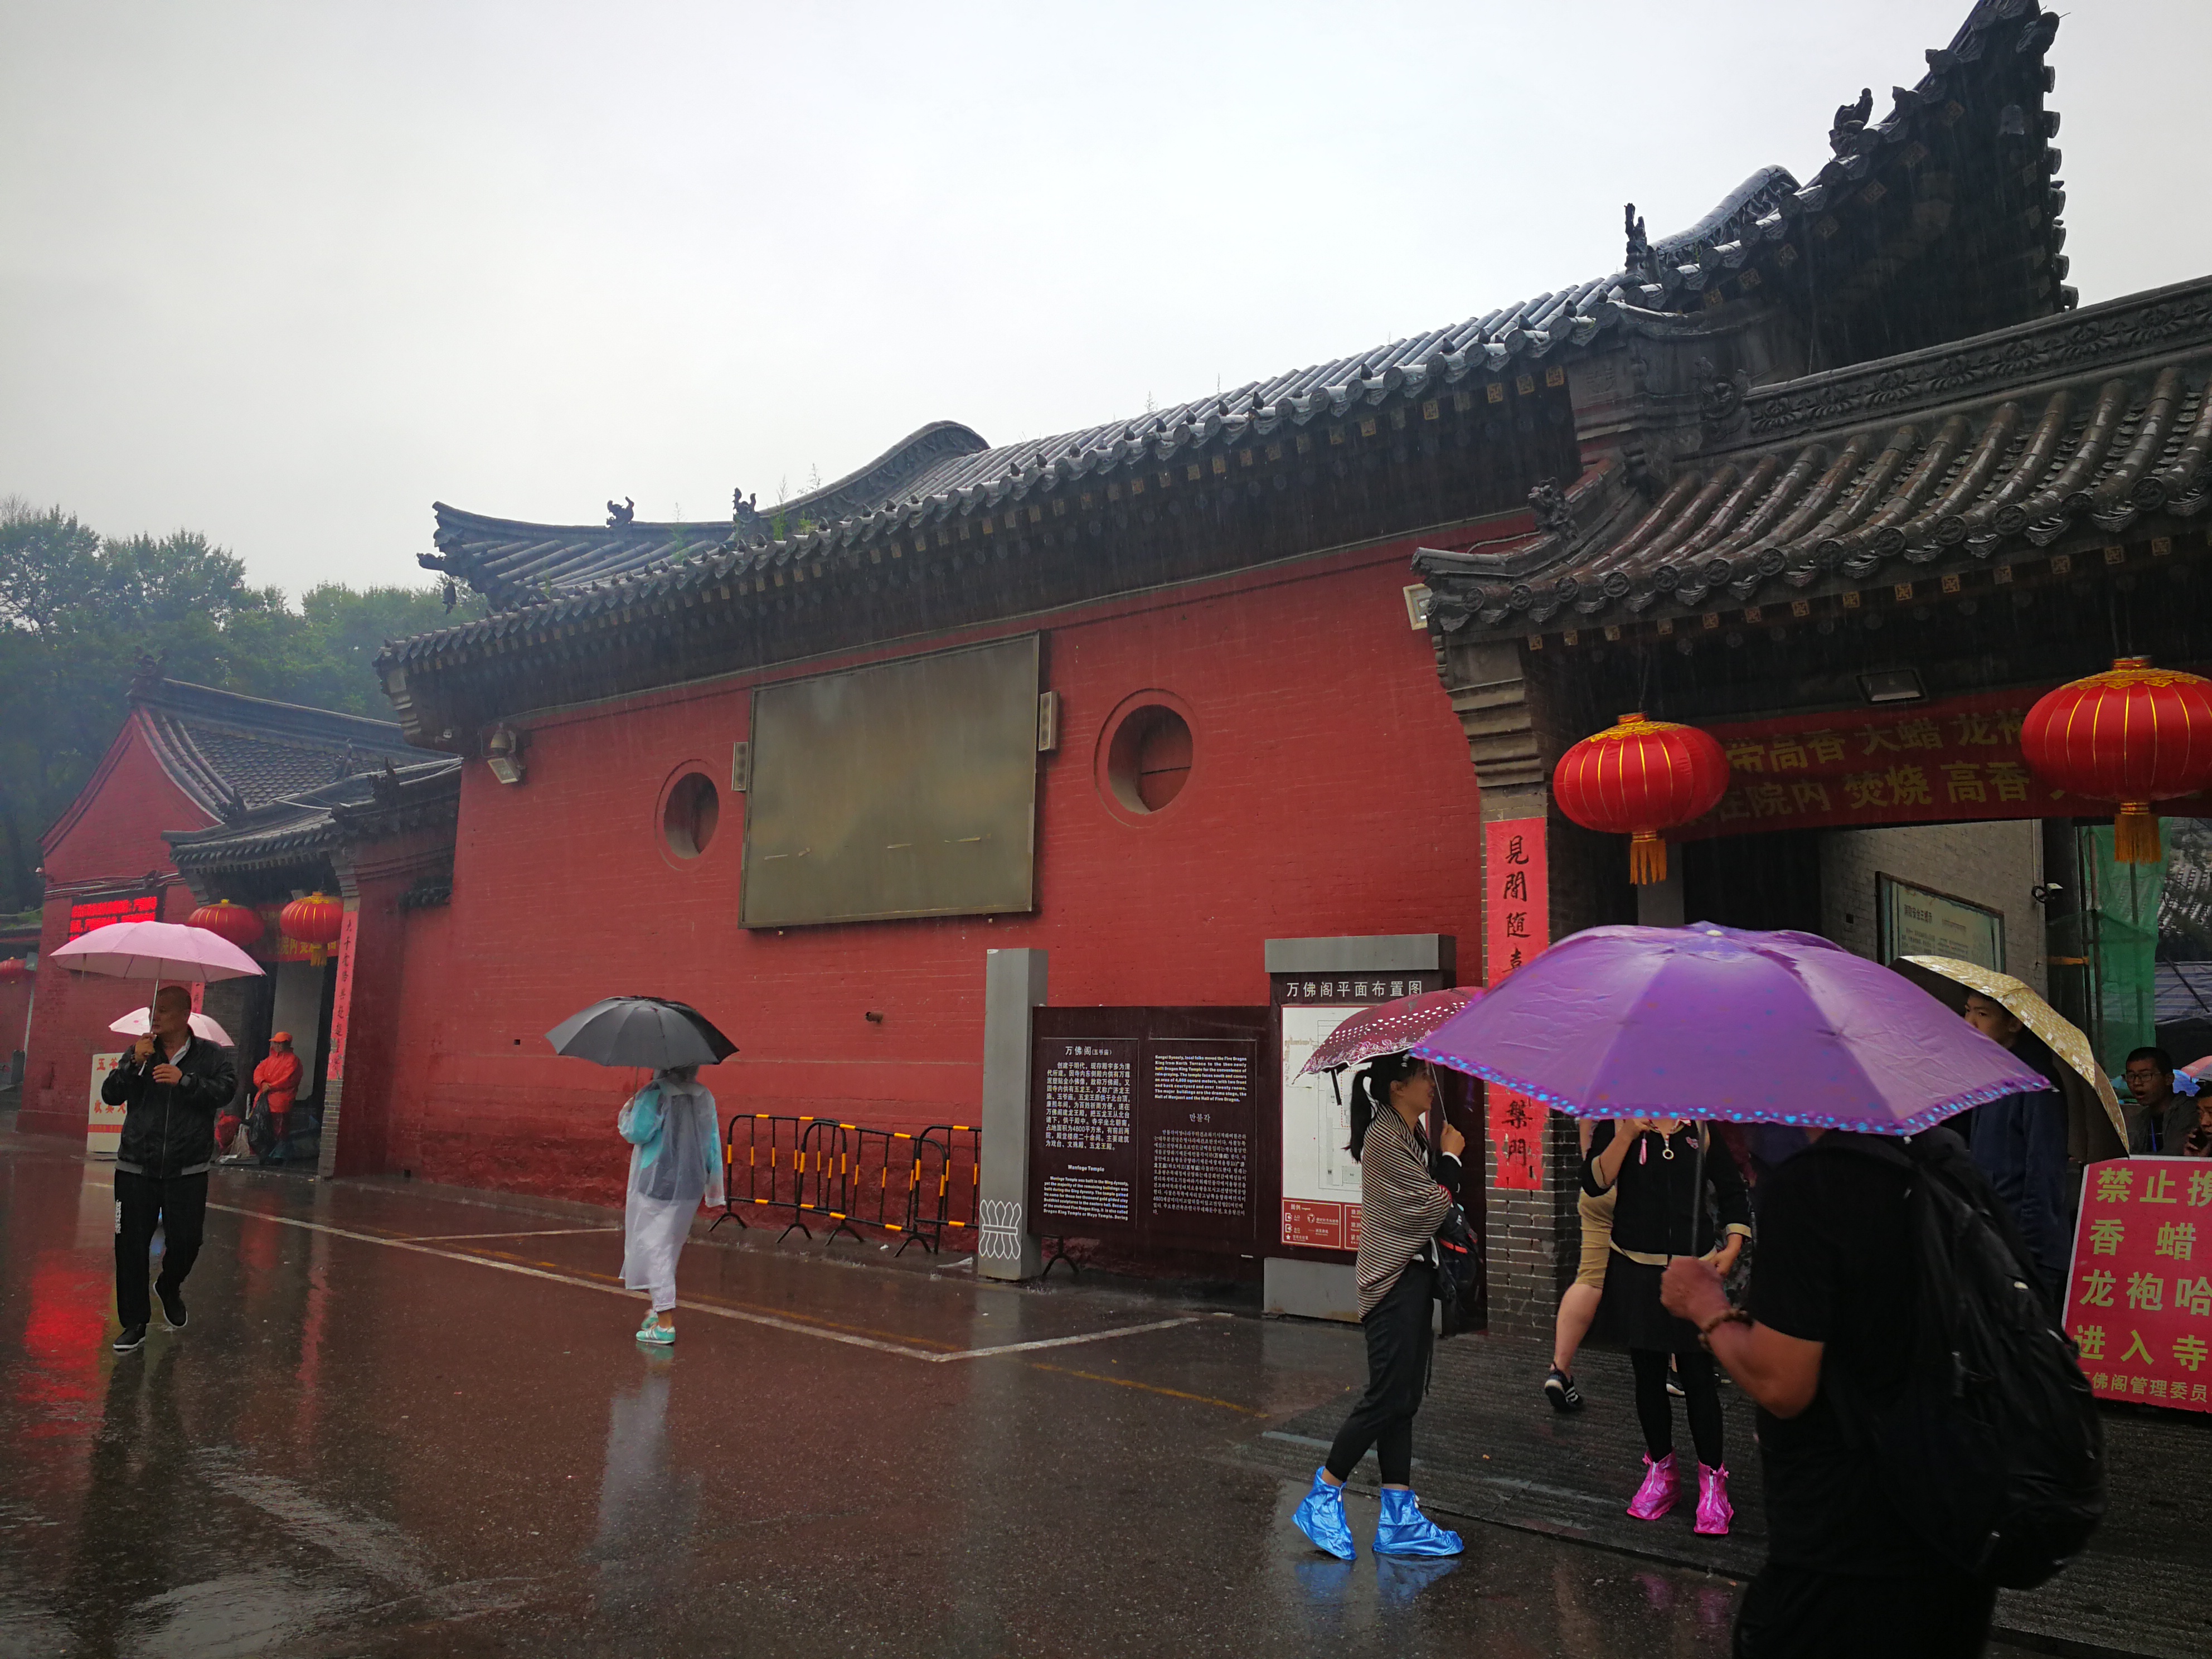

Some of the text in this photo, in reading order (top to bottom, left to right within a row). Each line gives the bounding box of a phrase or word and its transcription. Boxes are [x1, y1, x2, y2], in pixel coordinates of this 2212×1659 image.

[1286, 979, 1422, 998] 万佛阁平面布置图
[2096, 1167, 2212, 1207] 禁止携
[2079, 1269, 2212, 1316] 龙袍哈
[2074, 1325, 2209, 1371] 进入寺
[2082, 1371, 2208, 1403] 佛阁管理委员
